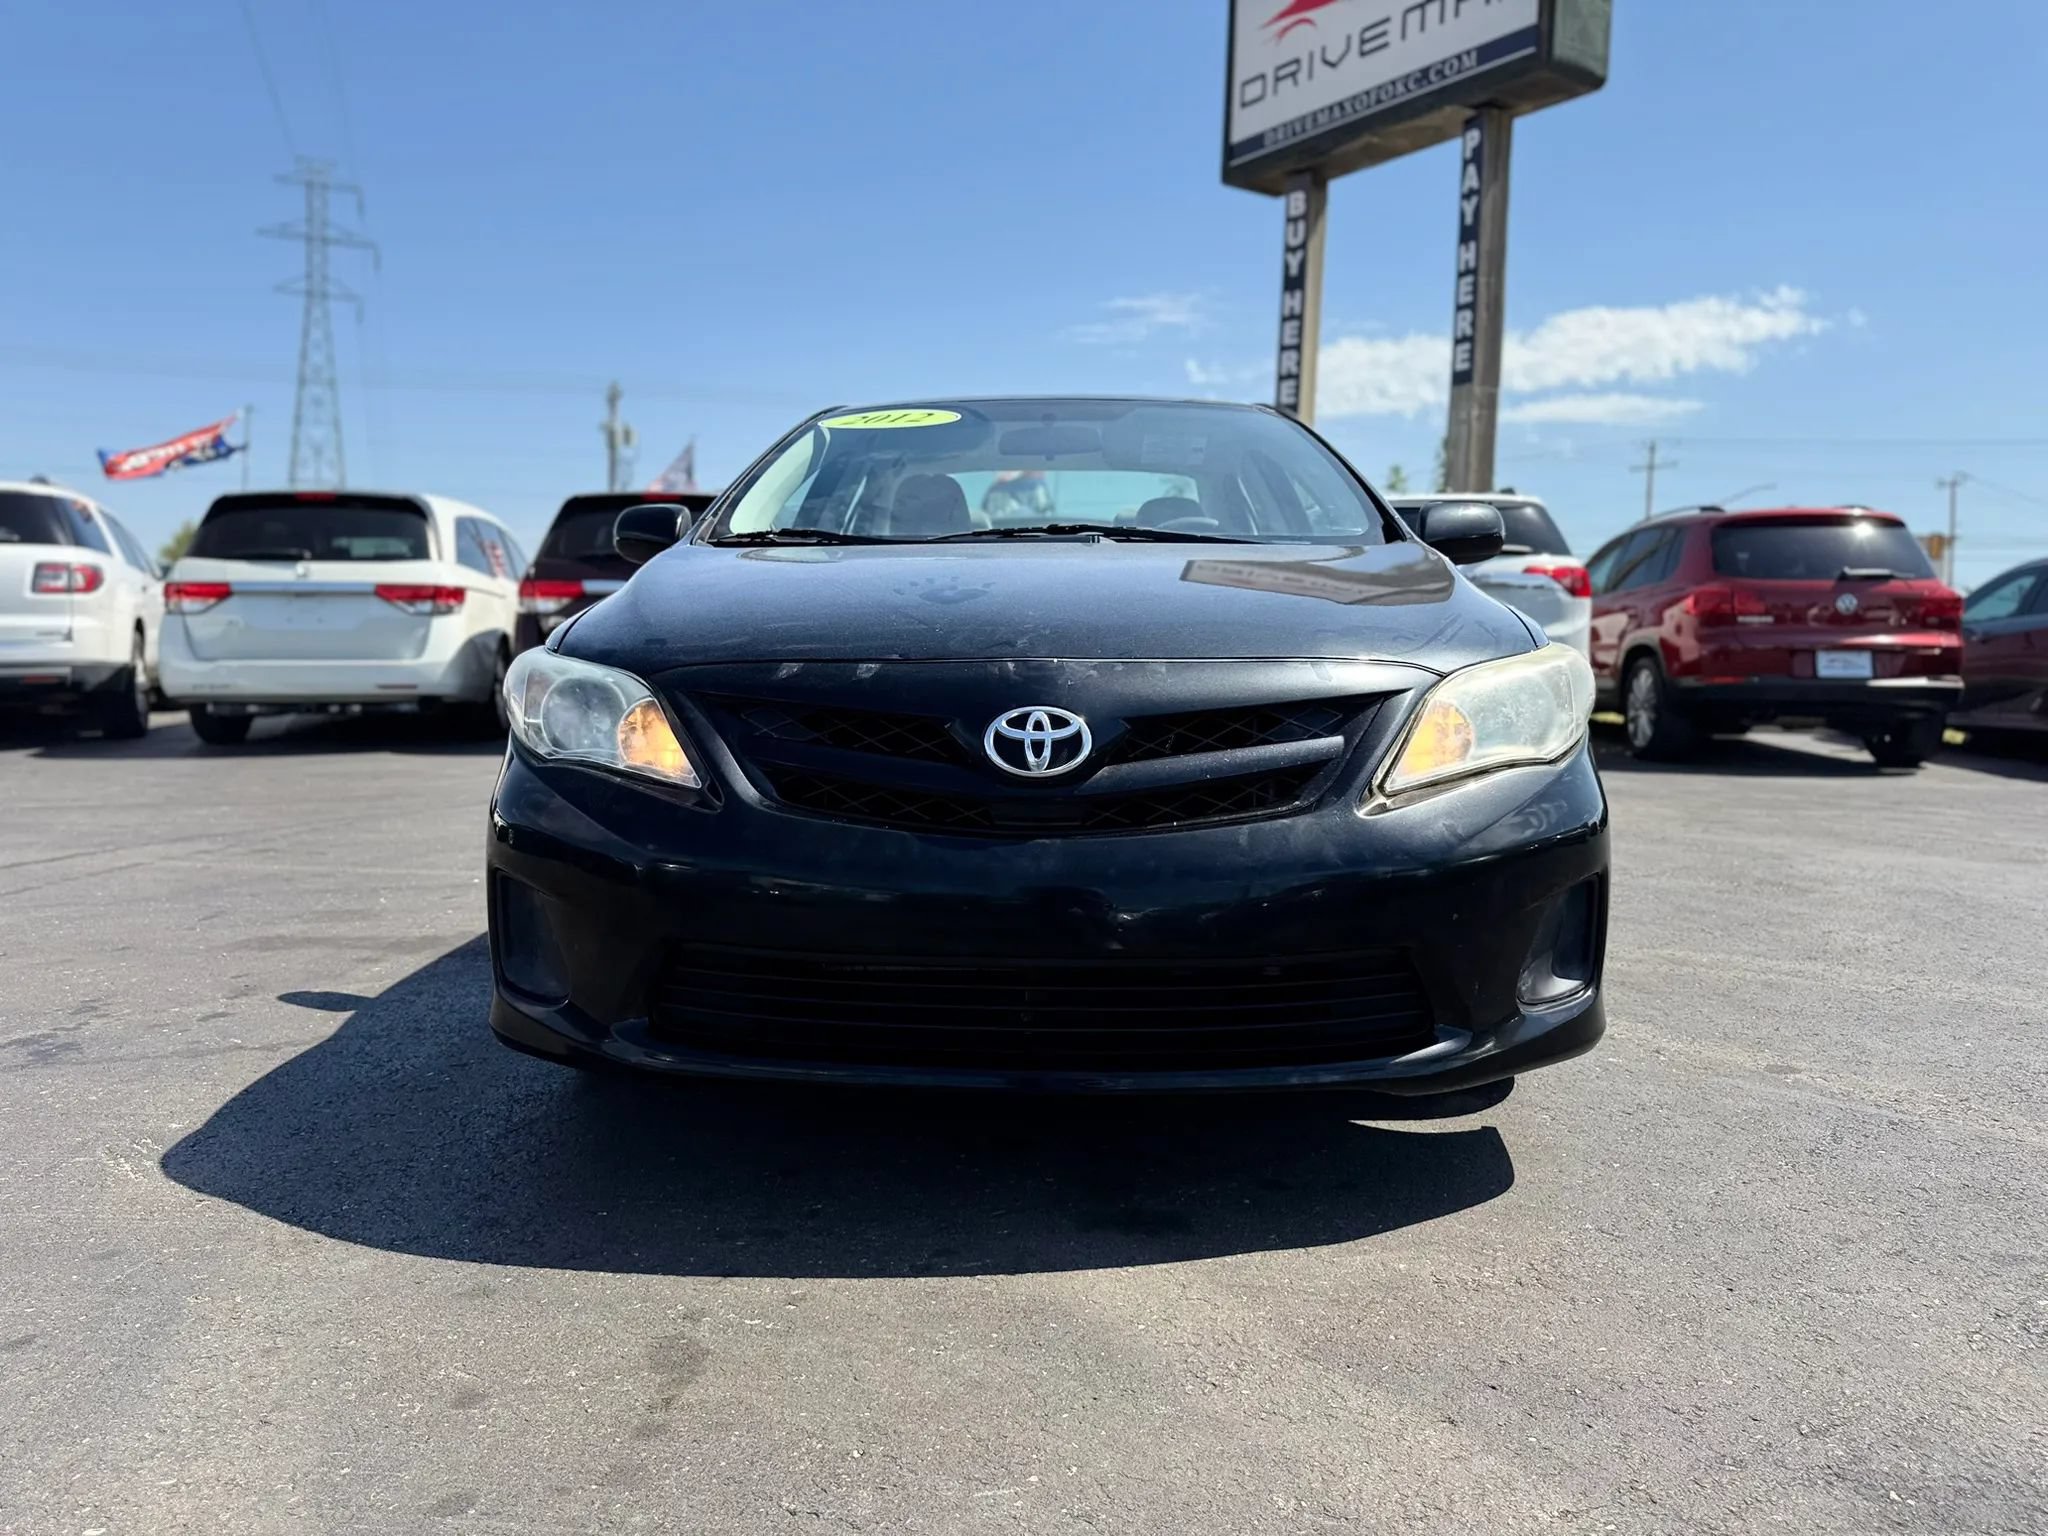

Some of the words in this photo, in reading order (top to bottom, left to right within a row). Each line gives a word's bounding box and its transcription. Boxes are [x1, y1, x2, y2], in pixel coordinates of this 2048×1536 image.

[1264, 50, 1478, 147] DRIVEMAXOFOKC.COM
[1461, 129, 1482, 226] PAY
[1286, 190, 1306, 277] BUY
[1280, 289, 1303, 404] HERE
[1455, 240, 1477, 372] HERE
[839, 412, 935, 426] 2012
